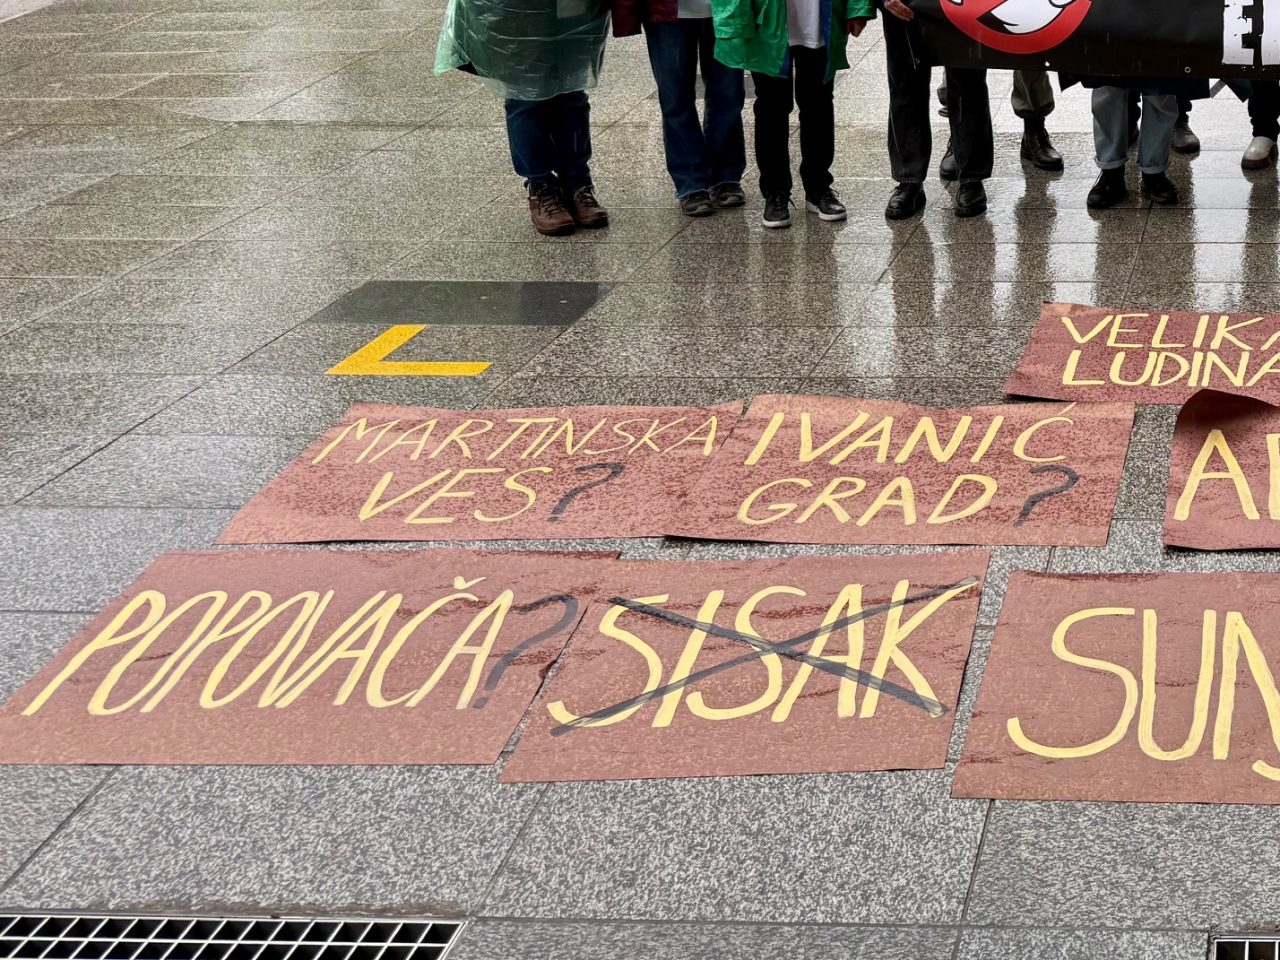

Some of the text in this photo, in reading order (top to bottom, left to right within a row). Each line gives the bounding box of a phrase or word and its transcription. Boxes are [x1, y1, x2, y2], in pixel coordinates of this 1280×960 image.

[312, 415, 718, 464] MARTINSKA
[743, 402, 1078, 466] IVANIĆ
[546, 577, 980, 728] SISAK
